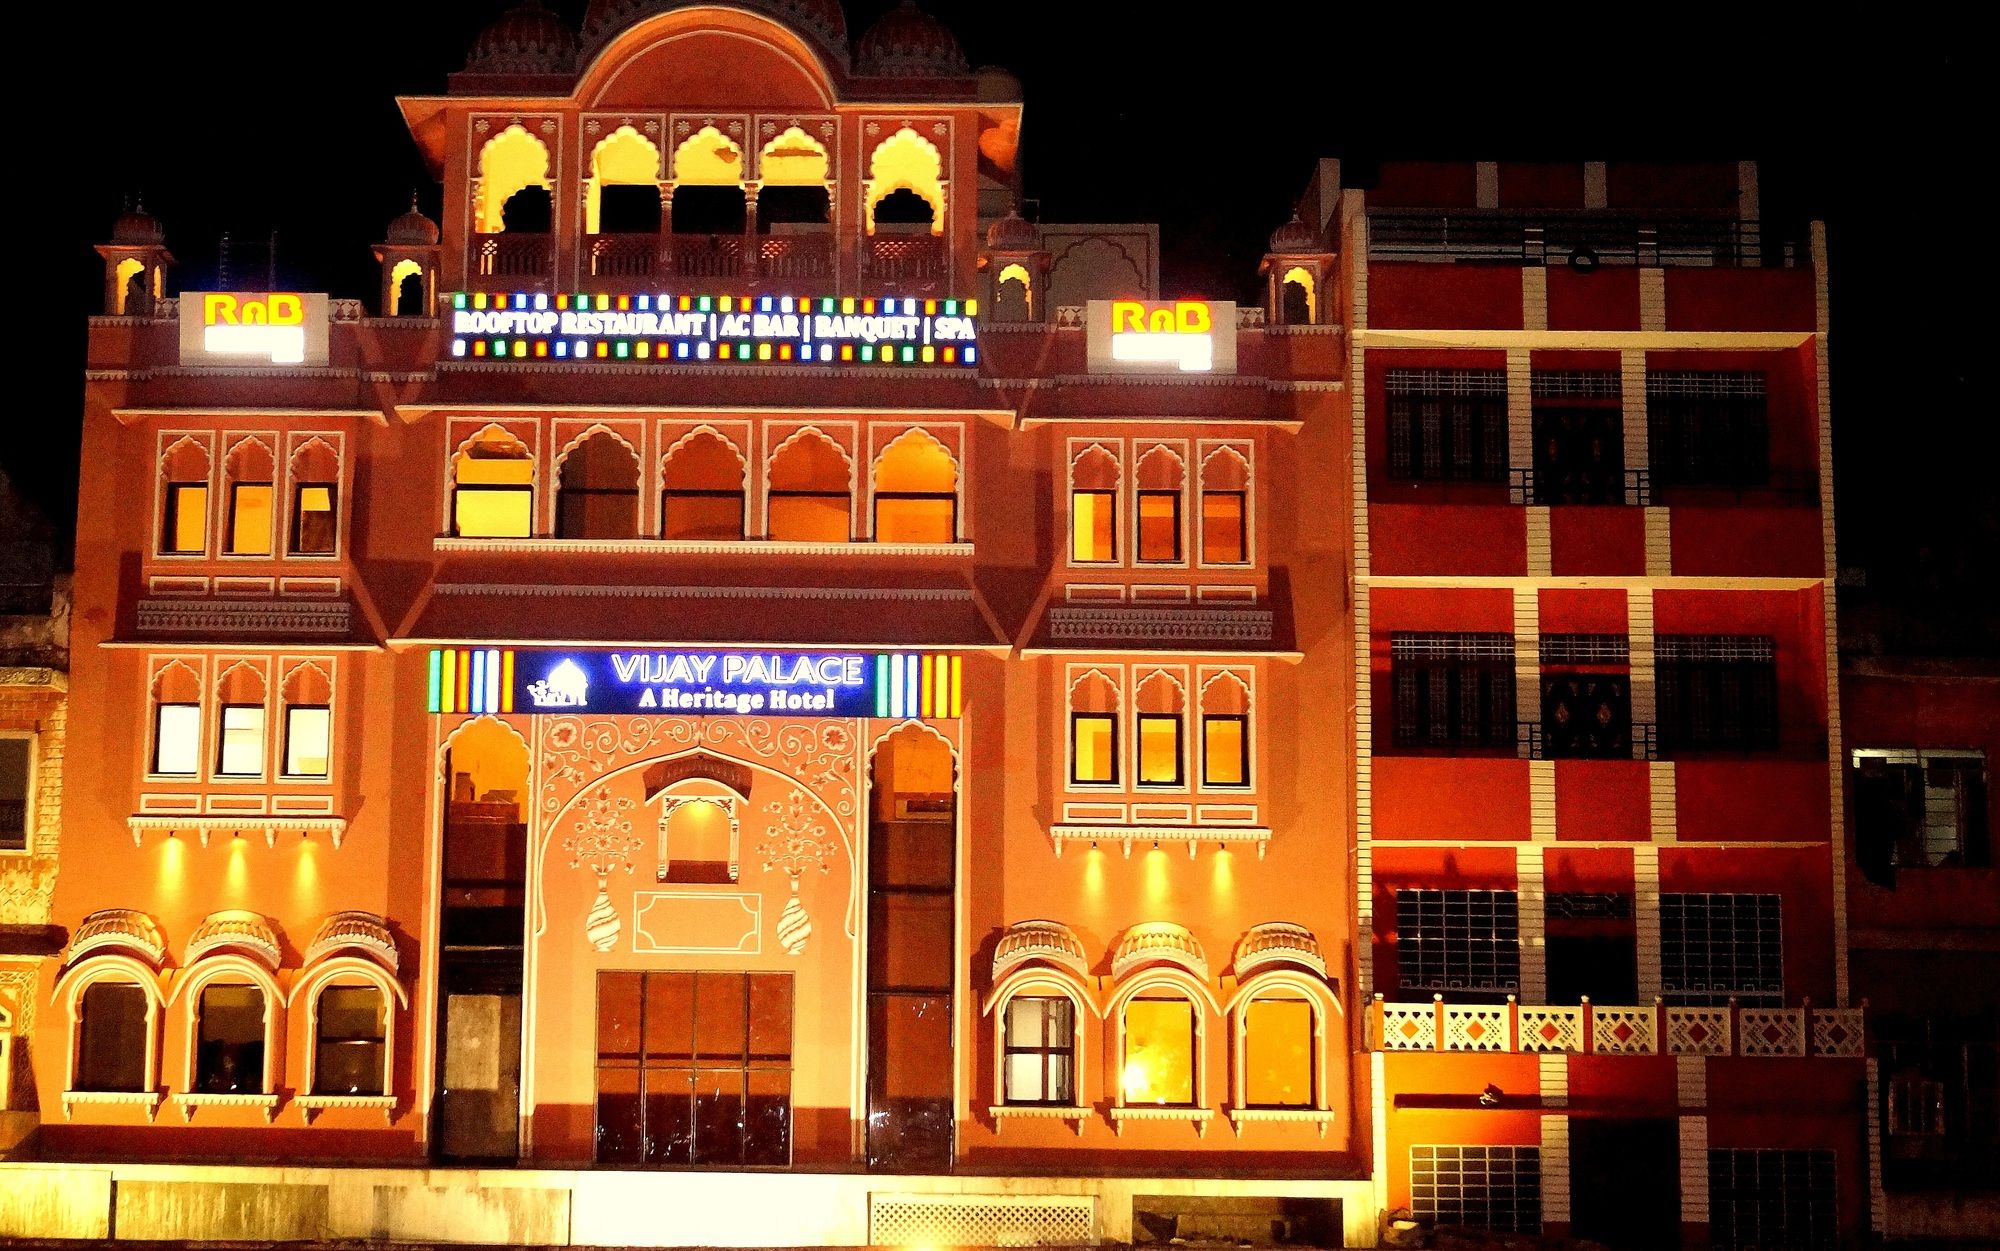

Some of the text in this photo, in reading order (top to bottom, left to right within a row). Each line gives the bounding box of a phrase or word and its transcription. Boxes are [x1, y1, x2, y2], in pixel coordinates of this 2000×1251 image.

[204, 294, 304, 326] RnB
[1112, 302, 1212, 333] RnB
[454, 311, 976, 342] ROOFTOP RESTAURANT AC BAR BANQUET SPA
[611, 654, 864, 685] VIJAY PALACE
[639, 686, 835, 713] A Heritage Hotel
